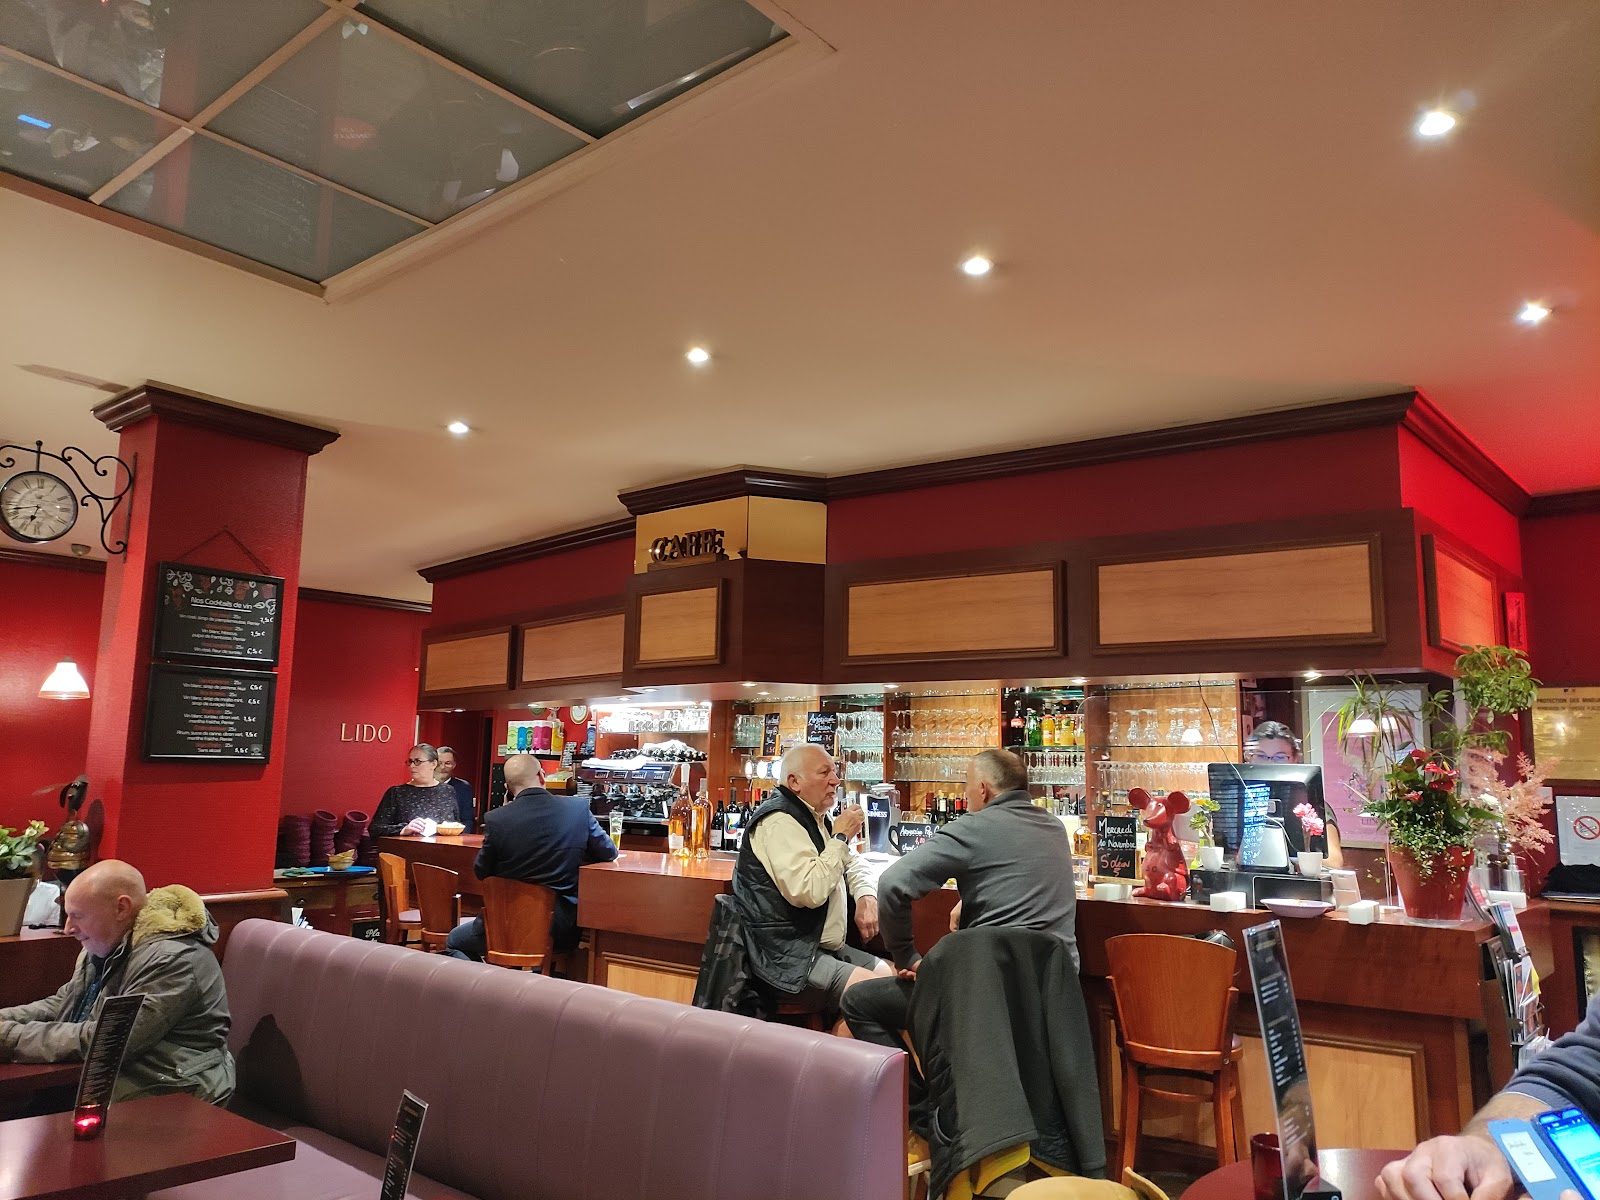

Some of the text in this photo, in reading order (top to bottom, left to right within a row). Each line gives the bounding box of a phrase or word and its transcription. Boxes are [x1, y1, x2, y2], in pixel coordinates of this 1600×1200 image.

[191, 597, 204, 605] Nos
[205, 598, 232, 607] Cocktails
[341, 722, 392, 743] LIDO
[1098, 817, 1133, 838] Mercredi
